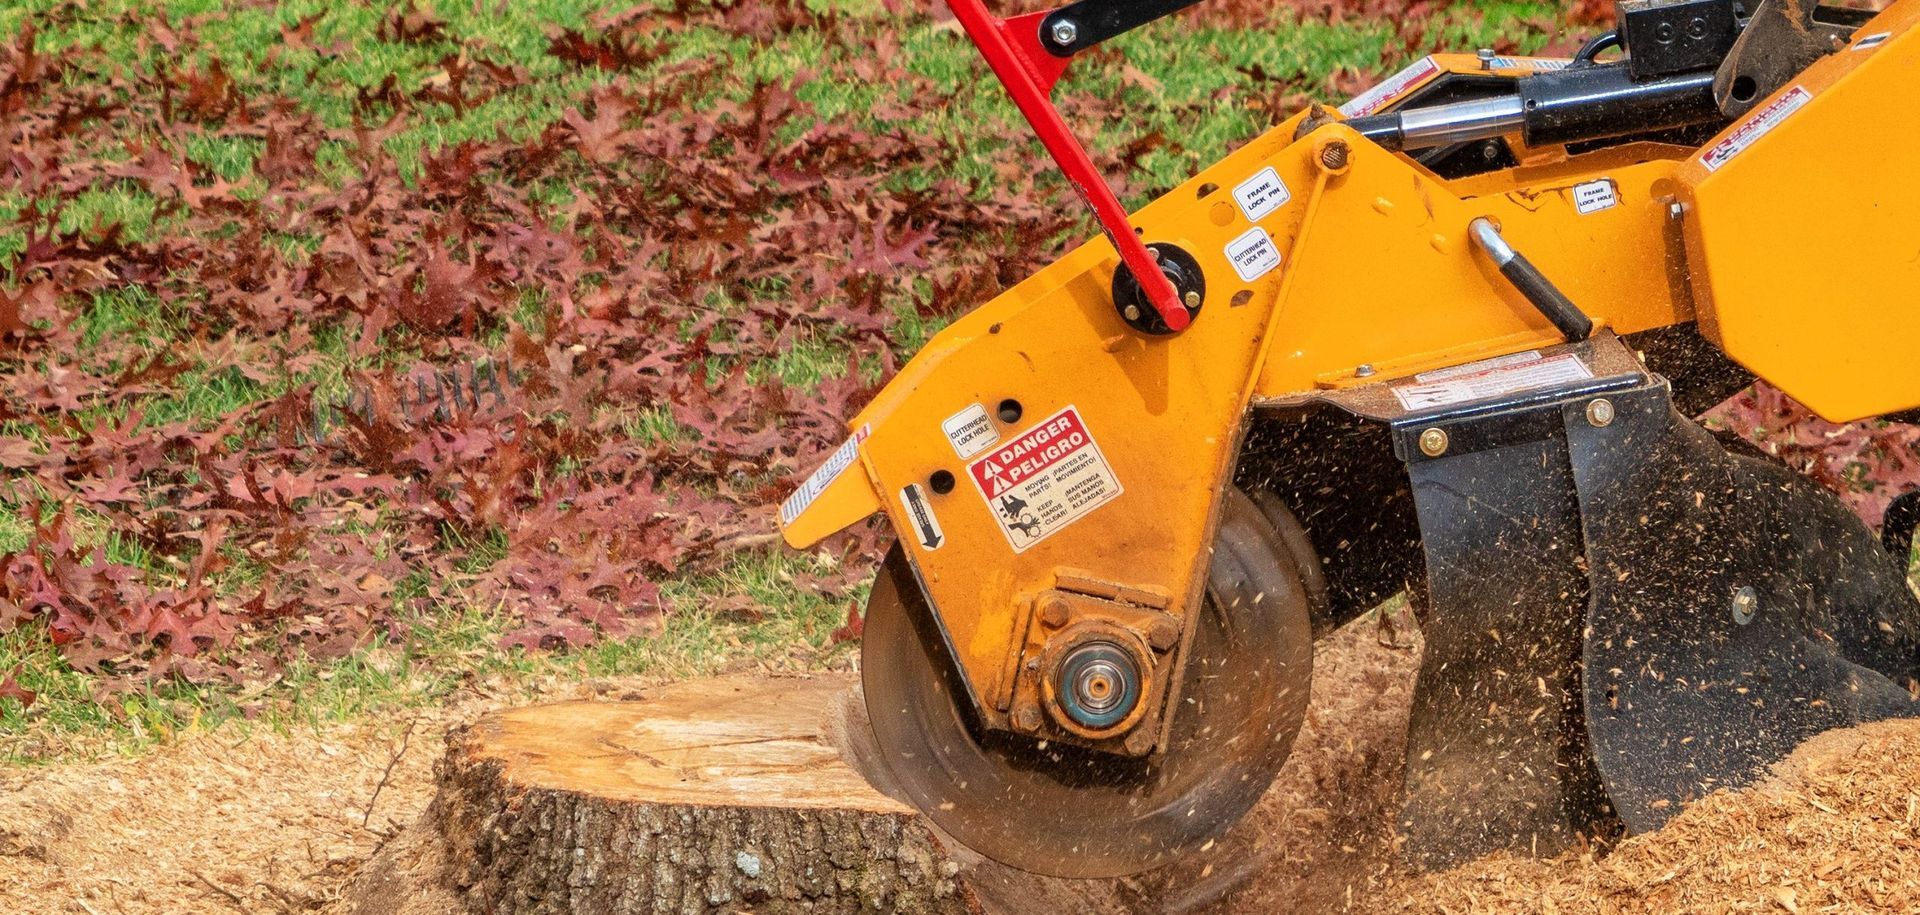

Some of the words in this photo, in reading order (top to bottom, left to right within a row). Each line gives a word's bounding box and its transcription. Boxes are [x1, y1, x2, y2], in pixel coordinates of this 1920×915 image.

[1247, 182, 1271, 200] FRAME
[1248, 196, 1266, 211] LOCK
[1268, 187, 1281, 198] PIN
[1584, 188, 1604, 197] FRAME
[1579, 199, 1595, 207] LOCK
[1234, 238, 1267, 262] CUTTERHEAD
[1243, 254, 1258, 267] LOCK
[1257, 248, 1267, 258] PIN
[950, 414, 987, 440] CUTTERHEAD
[957, 433, 974, 446] LOCK
[972, 423, 990, 440] HOLE
[999, 416, 1073, 465] DANGER
[1009, 431, 1084, 482] PELIGRO
[1077, 452, 1088, 463] EN
[1055, 456, 1097, 483] MOVIMIENTO!
[1024, 475, 1050, 492] MOVING
[1029, 482, 1052, 499] PARTS!
[1065, 473, 1101, 497] ¡MANTENGA
[1067, 492, 1082, 503] SUS
[1081, 479, 1105, 496] MANOS
[1036, 499, 1054, 513] KEEP
[1072, 487, 1106, 510] ALEJADAS!
[1041, 503, 1063, 519] HANDS
[1045, 509, 1068, 526] CLEAR!
